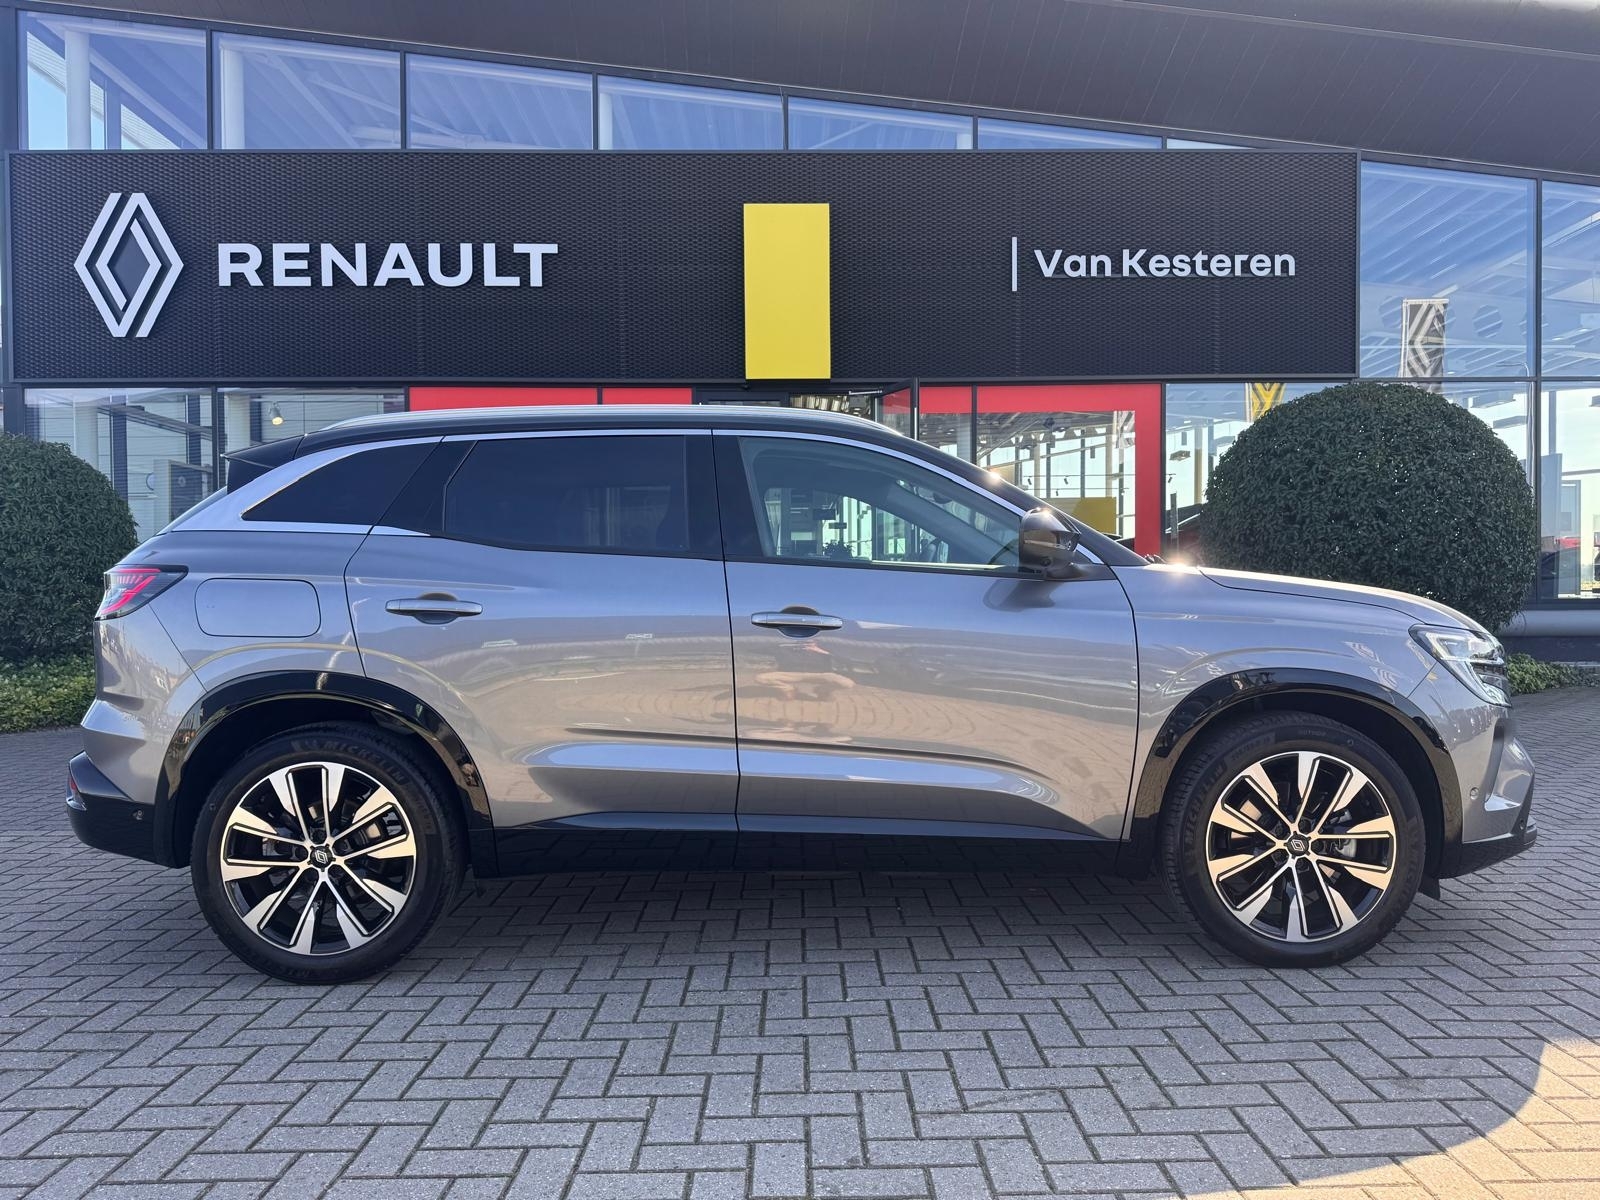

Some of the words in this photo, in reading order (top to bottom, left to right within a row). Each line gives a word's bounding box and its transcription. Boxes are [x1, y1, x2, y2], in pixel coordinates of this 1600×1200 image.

[218, 243, 558, 287] RENAULT
[1034, 250, 1111, 277] Van
[1122, 249, 1295, 276] Kesteren
